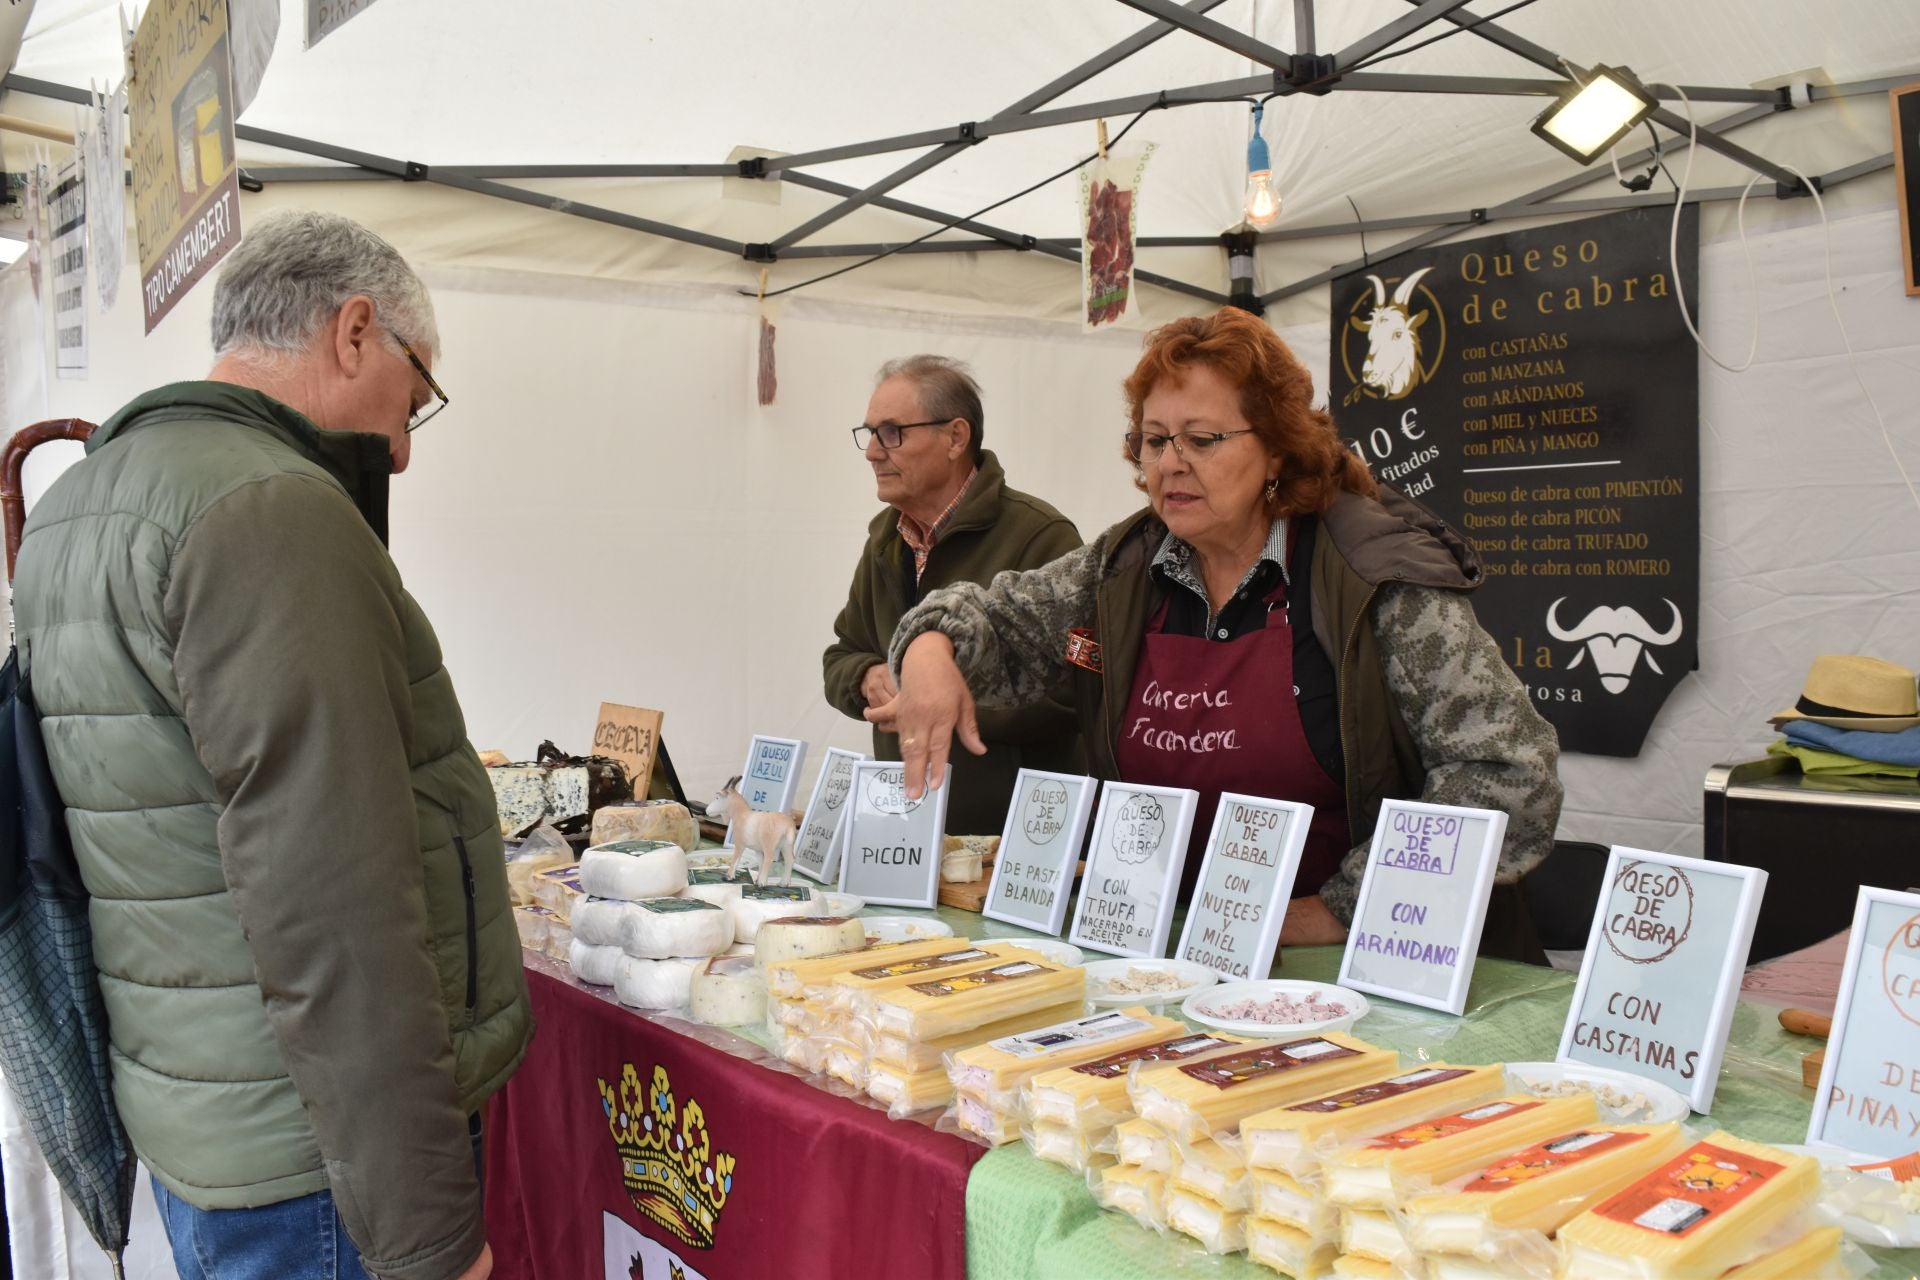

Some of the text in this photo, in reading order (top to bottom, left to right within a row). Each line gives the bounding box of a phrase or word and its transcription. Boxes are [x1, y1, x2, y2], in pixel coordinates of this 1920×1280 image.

[145, 190, 231, 317] TIPO CAMEMBERT
[1461, 240, 1599, 285] Queso
[1463, 272, 1668, 326] de cabra
[1463, 332, 1568, 361] con CASTAÑAS
[1463, 358, 1565, 385] con MANZANA
[1463, 381, 1585, 408] con ARÁNDANOS
[1463, 406, 1598, 432] con MIEL y NUECES
[1350, 407, 1426, 467] 10 €
[1463, 431, 1599, 456] con PIÑA y MANGO
[1381, 445, 1440, 482] fitados
[1463, 479, 1683, 506] Queso de cabra con PIMENTÓN
[1463, 507, 1621, 530] Queso de cabra PICÓN
[1511, 536, 1527, 552] de
[1532, 535, 1571, 551] cabra
[1576, 532, 1649, 550] TRUFADO
[1482, 559, 1671, 577] eso de cabra con ROMERO
[761, 745, 791, 762] QUESO
[756, 761, 783, 778] AZUL
[879, 772, 905, 784] QUE
[753, 790, 768, 804] DE
[1032, 788, 1067, 804] QUESO
[1036, 806, 1055, 819] DE
[1121, 805, 1161, 821] QUESO
[1235, 805, 1278, 830] QUESO
[1393, 813, 1456, 836] QUESO
[1026, 819, 1062, 835] CABRA
[1129, 823, 1146, 837] DE
[1242, 826, 1260, 842] DE
[809, 839, 821, 850] SIN
[1119, 840, 1158, 856] CABRA
[1225, 841, 1268, 865] CABRA
[1406, 834, 1432, 852] DE
[798, 848, 825, 865] LACTOSA
[1003, 860, 1021, 876] DE
[1384, 848, 1442, 873] CABRA
[1004, 881, 1055, 908] BLANDA
[1103, 878, 1130, 896] CON
[1224, 874, 1251, 894] CON
[1623, 870, 1679, 898] QESO
[1087, 896, 1136, 921] TRUFA
[1202, 891, 1263, 922] NUECES
[1391, 902, 1427, 925] CON
[1633, 895, 1665, 919] DE
[1080, 914, 1153, 938] MACERADO EN
[1091, 927, 1124, 942] ACEITE
[1611, 913, 1678, 946] CABRA
[1203, 927, 1235, 953] MIEL
[1186, 946, 1250, 979] ECOLOGICA
[1608, 991, 1662, 1026] CON
[1574, 1022, 1699, 1079] CASTAÑAS
